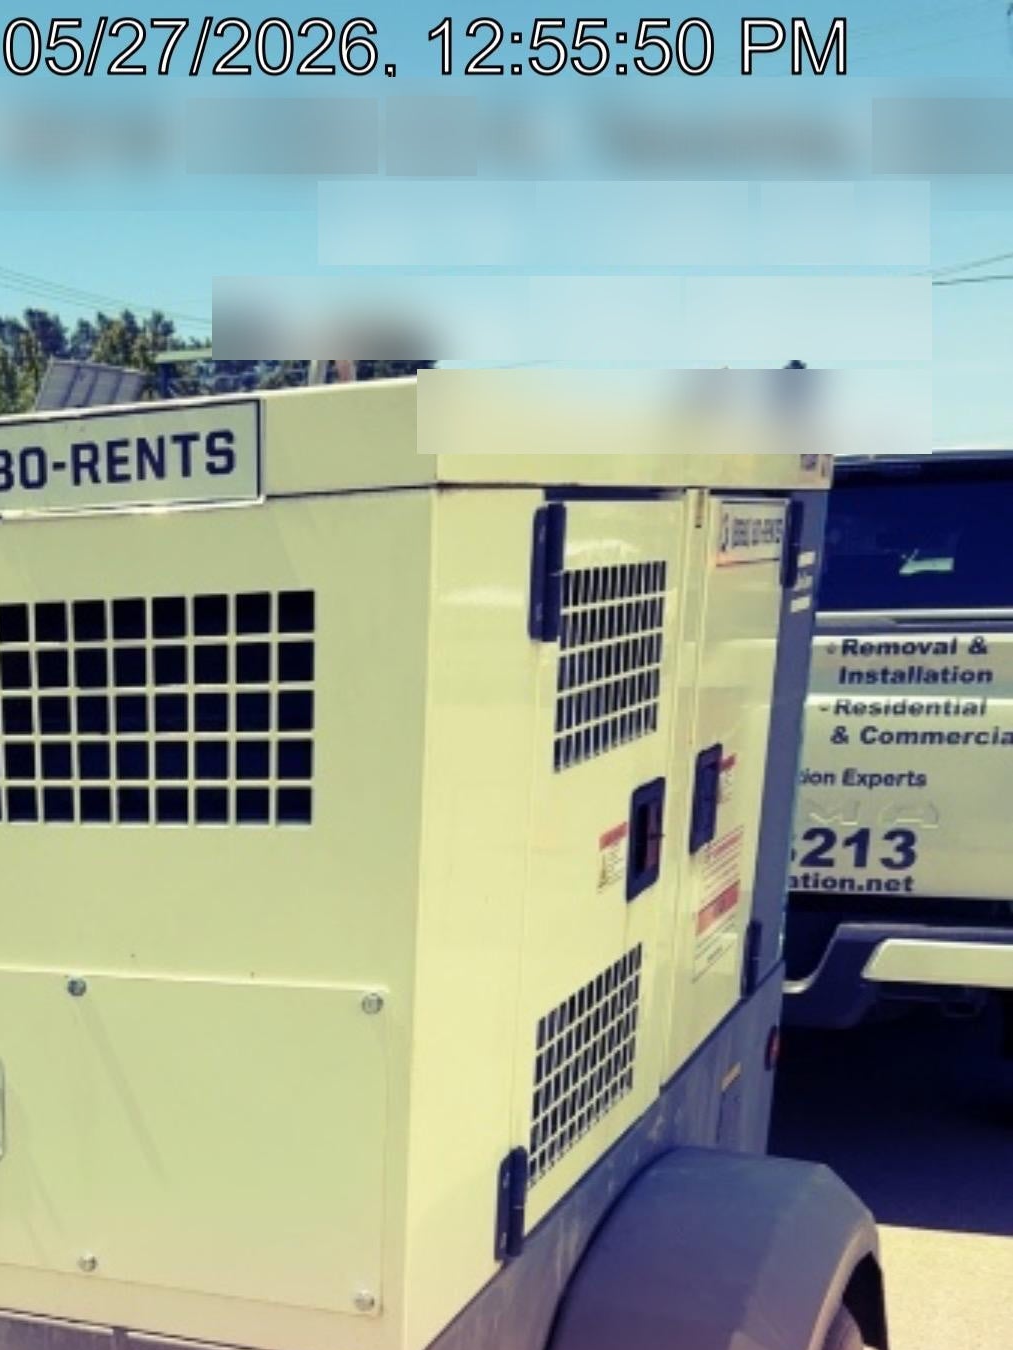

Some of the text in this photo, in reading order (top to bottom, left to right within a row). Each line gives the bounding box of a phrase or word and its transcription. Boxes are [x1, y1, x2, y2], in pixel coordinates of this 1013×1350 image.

[841, 637, 958, 657] Removal
[968, 635, 988, 656] &
[838, 664, 994, 685] Installation
[833, 699, 987, 717] Residential
[830, 725, 849, 745] &
[841, 767, 928, 790] Experts
[791, 826, 917, 870] 213
